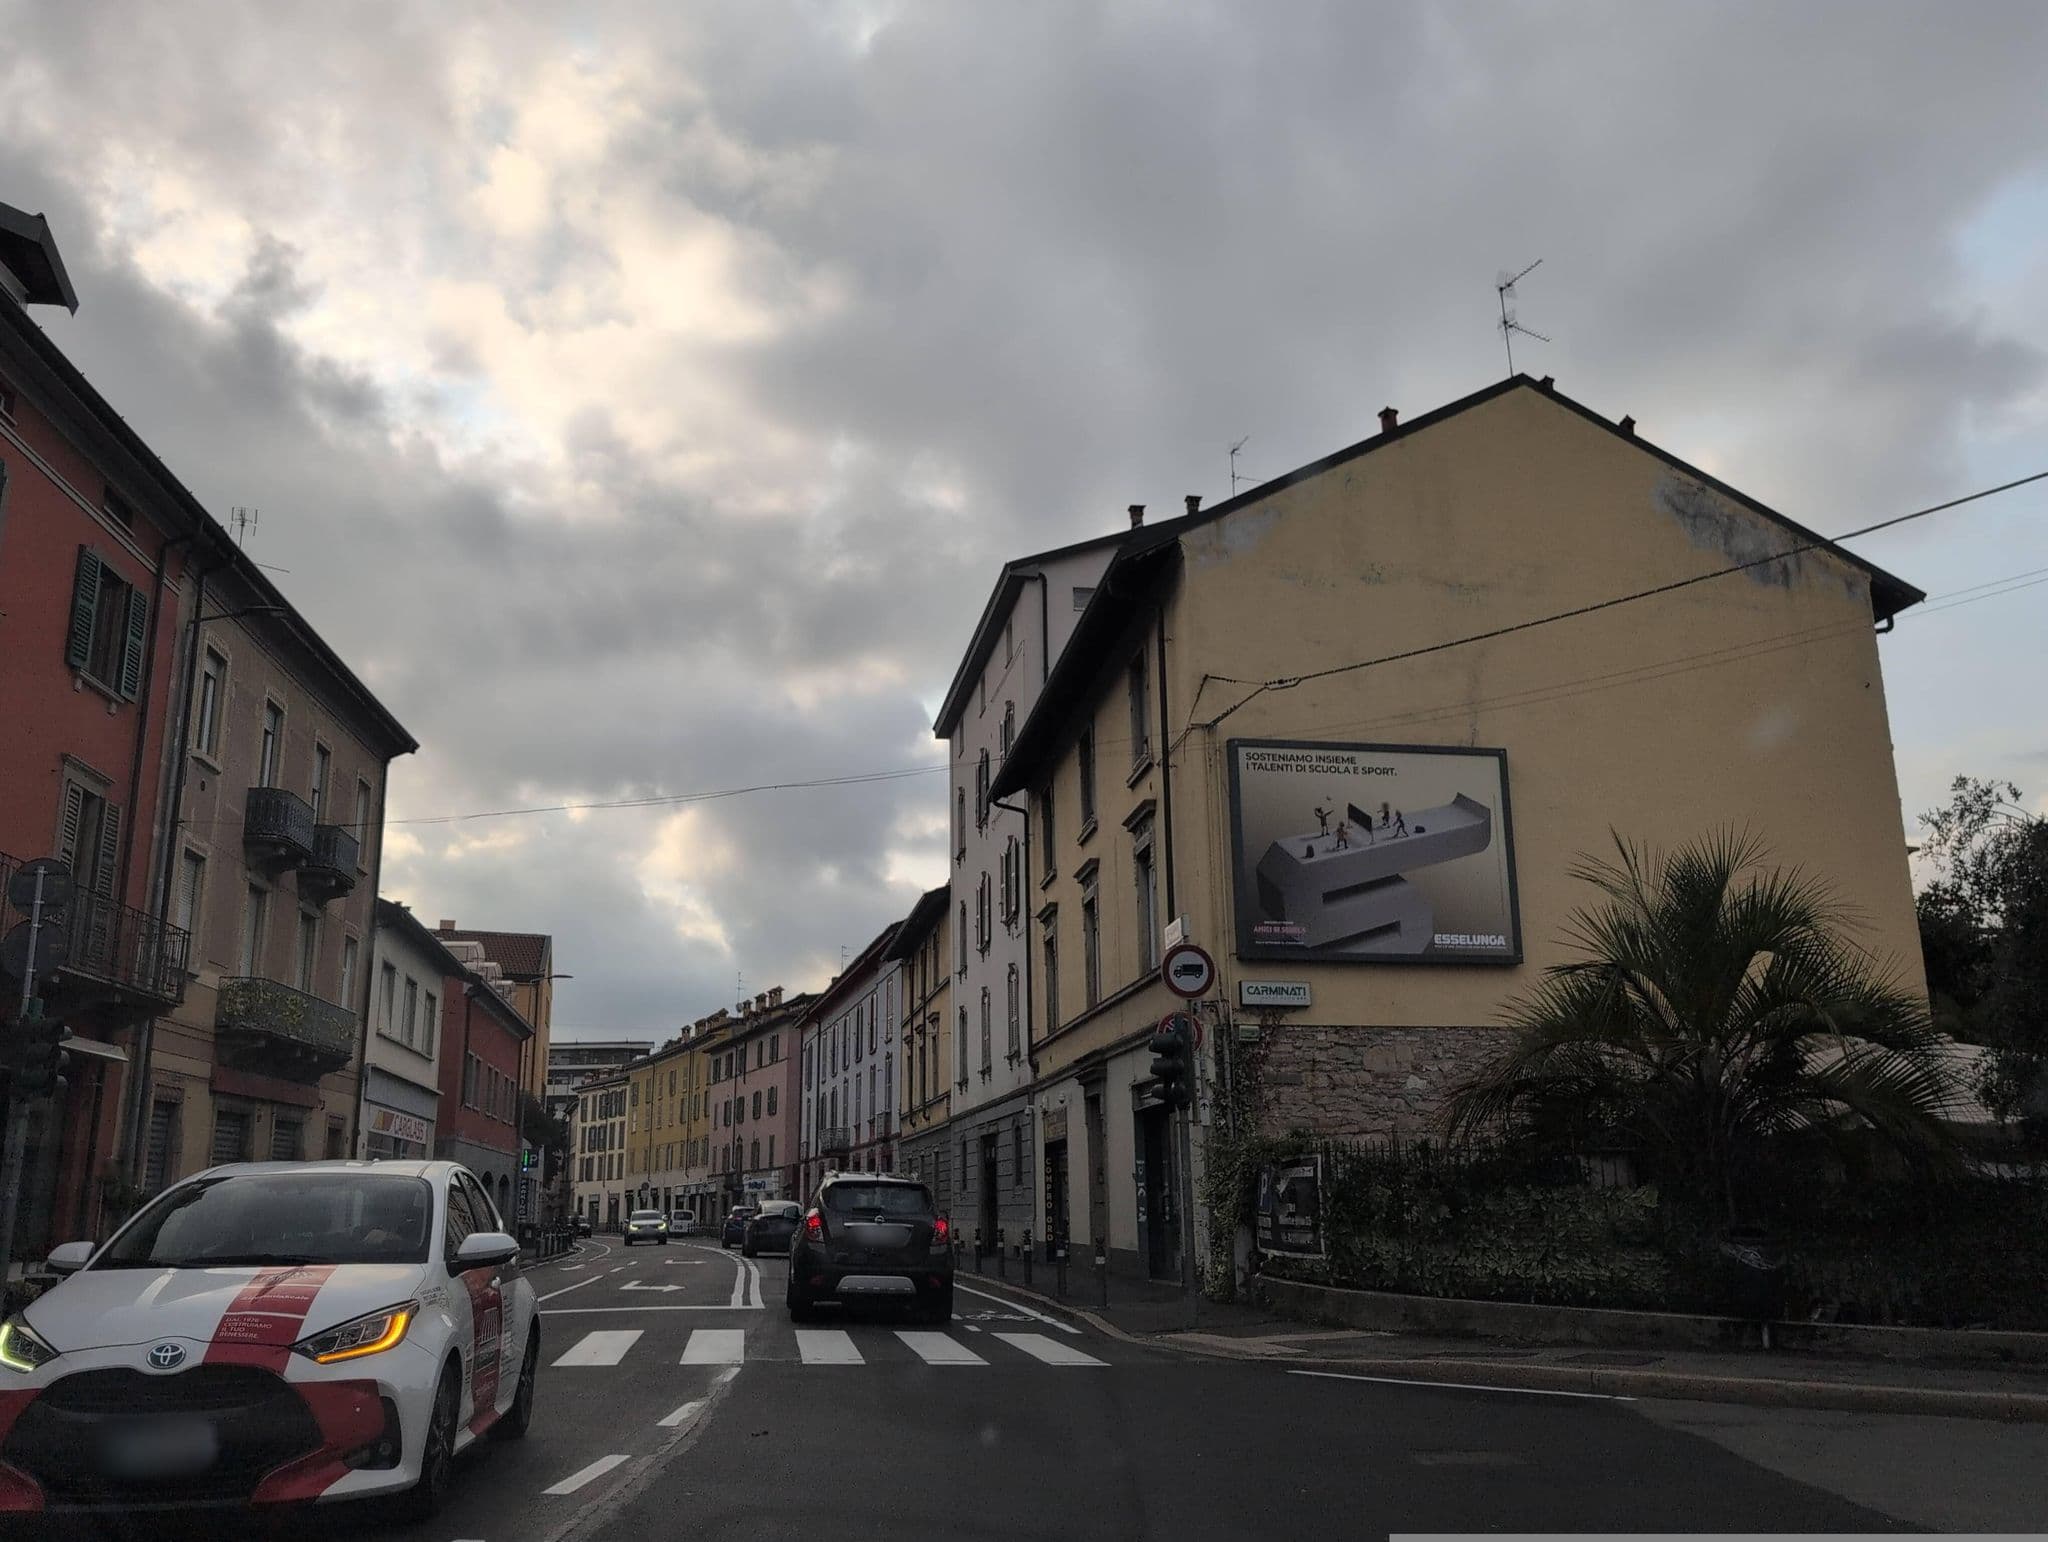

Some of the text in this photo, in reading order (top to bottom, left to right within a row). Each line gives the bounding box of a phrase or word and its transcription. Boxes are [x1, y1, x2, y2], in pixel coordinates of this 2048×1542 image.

[1245, 752, 1356, 765] SOSTENIAMO INSIEME
[1251, 762, 1293, 772] TALENTI
[1295, 764, 1306, 773] DI
[1308, 764, 1351, 775] SCUOLA
[1353, 766, 1359, 775] E
[1361, 766, 1397, 777] SPORT.
[1434, 933, 1506, 945] ESSELUNGA
[1247, 985, 1306, 996] CARMINATI
[529, 1154, 538, 1165] P
[1045, 1158, 1054, 1241] COMPRO ORO
